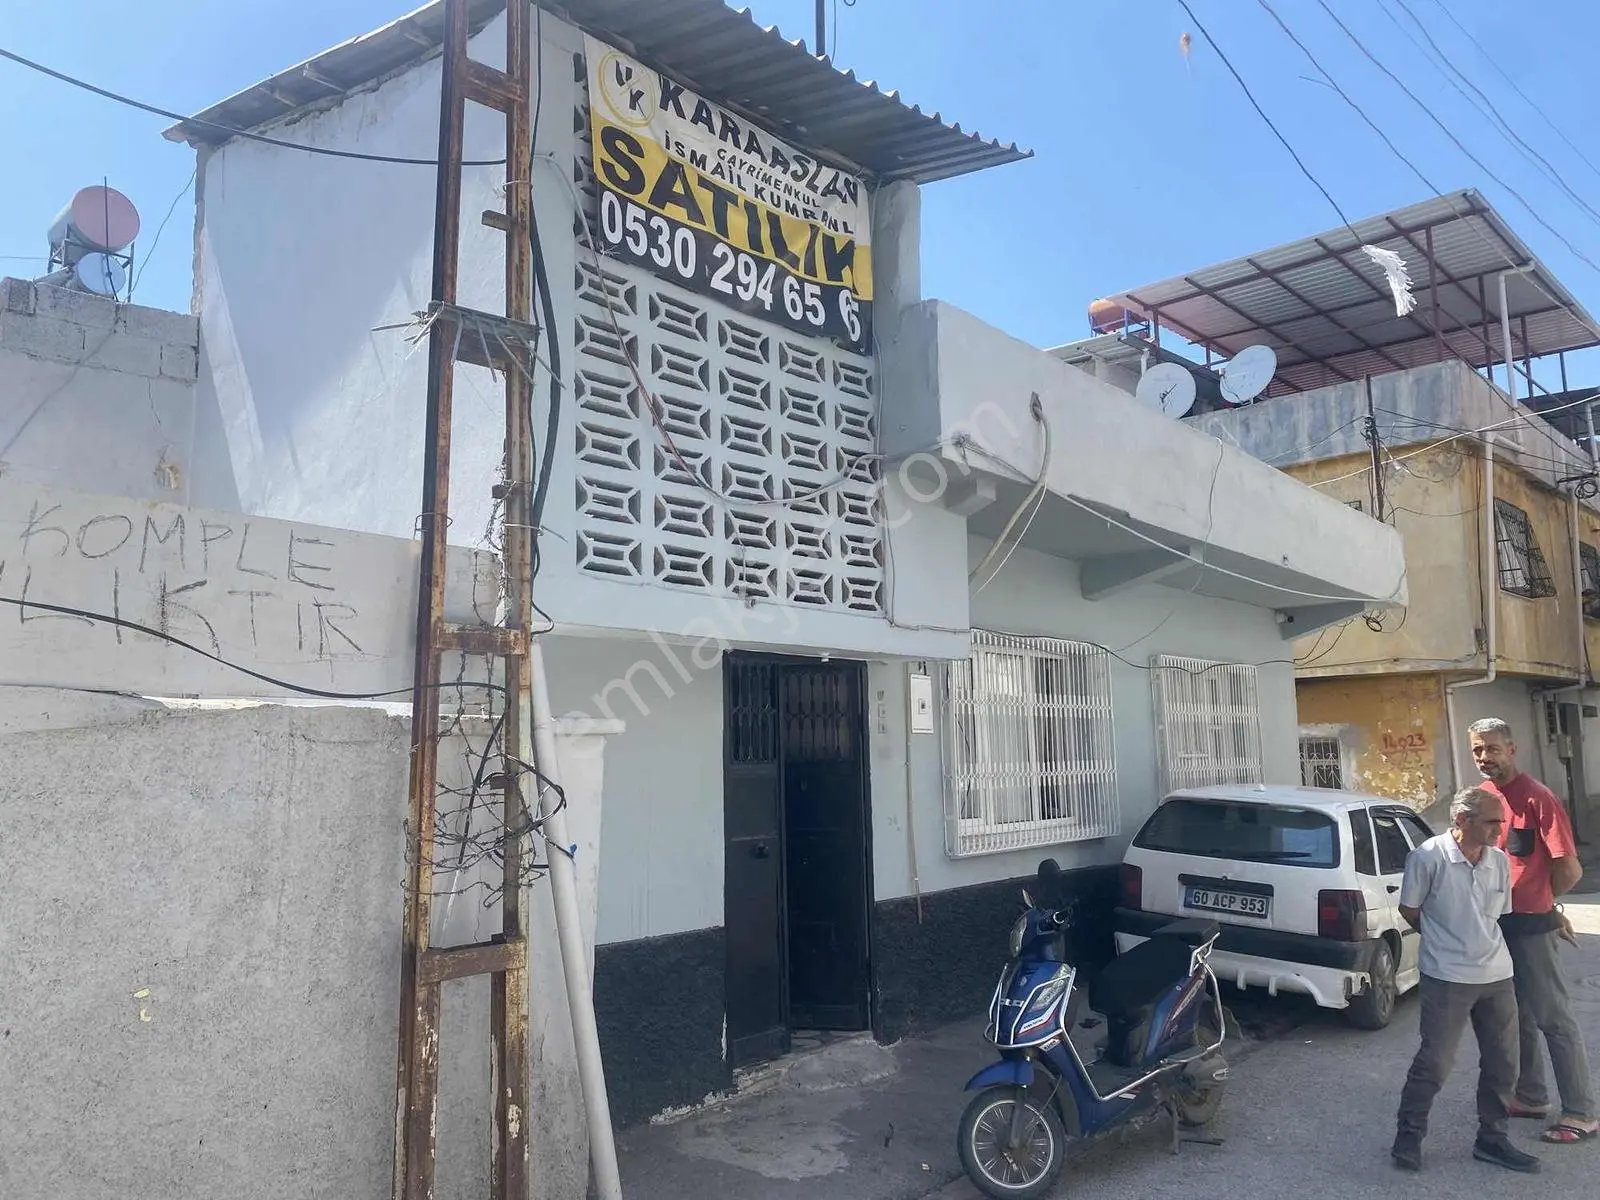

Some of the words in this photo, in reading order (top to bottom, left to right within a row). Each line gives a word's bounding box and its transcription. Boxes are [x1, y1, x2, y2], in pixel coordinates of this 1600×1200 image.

[599, 126, 859, 296] SATILIK
[601, 190, 696, 278] 0530
[710, 242, 776, 311] 294
[783, 275, 826, 326] 65
[20, 499, 336, 592] KOMPLE
[1193, 891, 1209, 905] 60
[1212, 894, 1236, 908] ACP
[1240, 898, 1266, 913] 953
